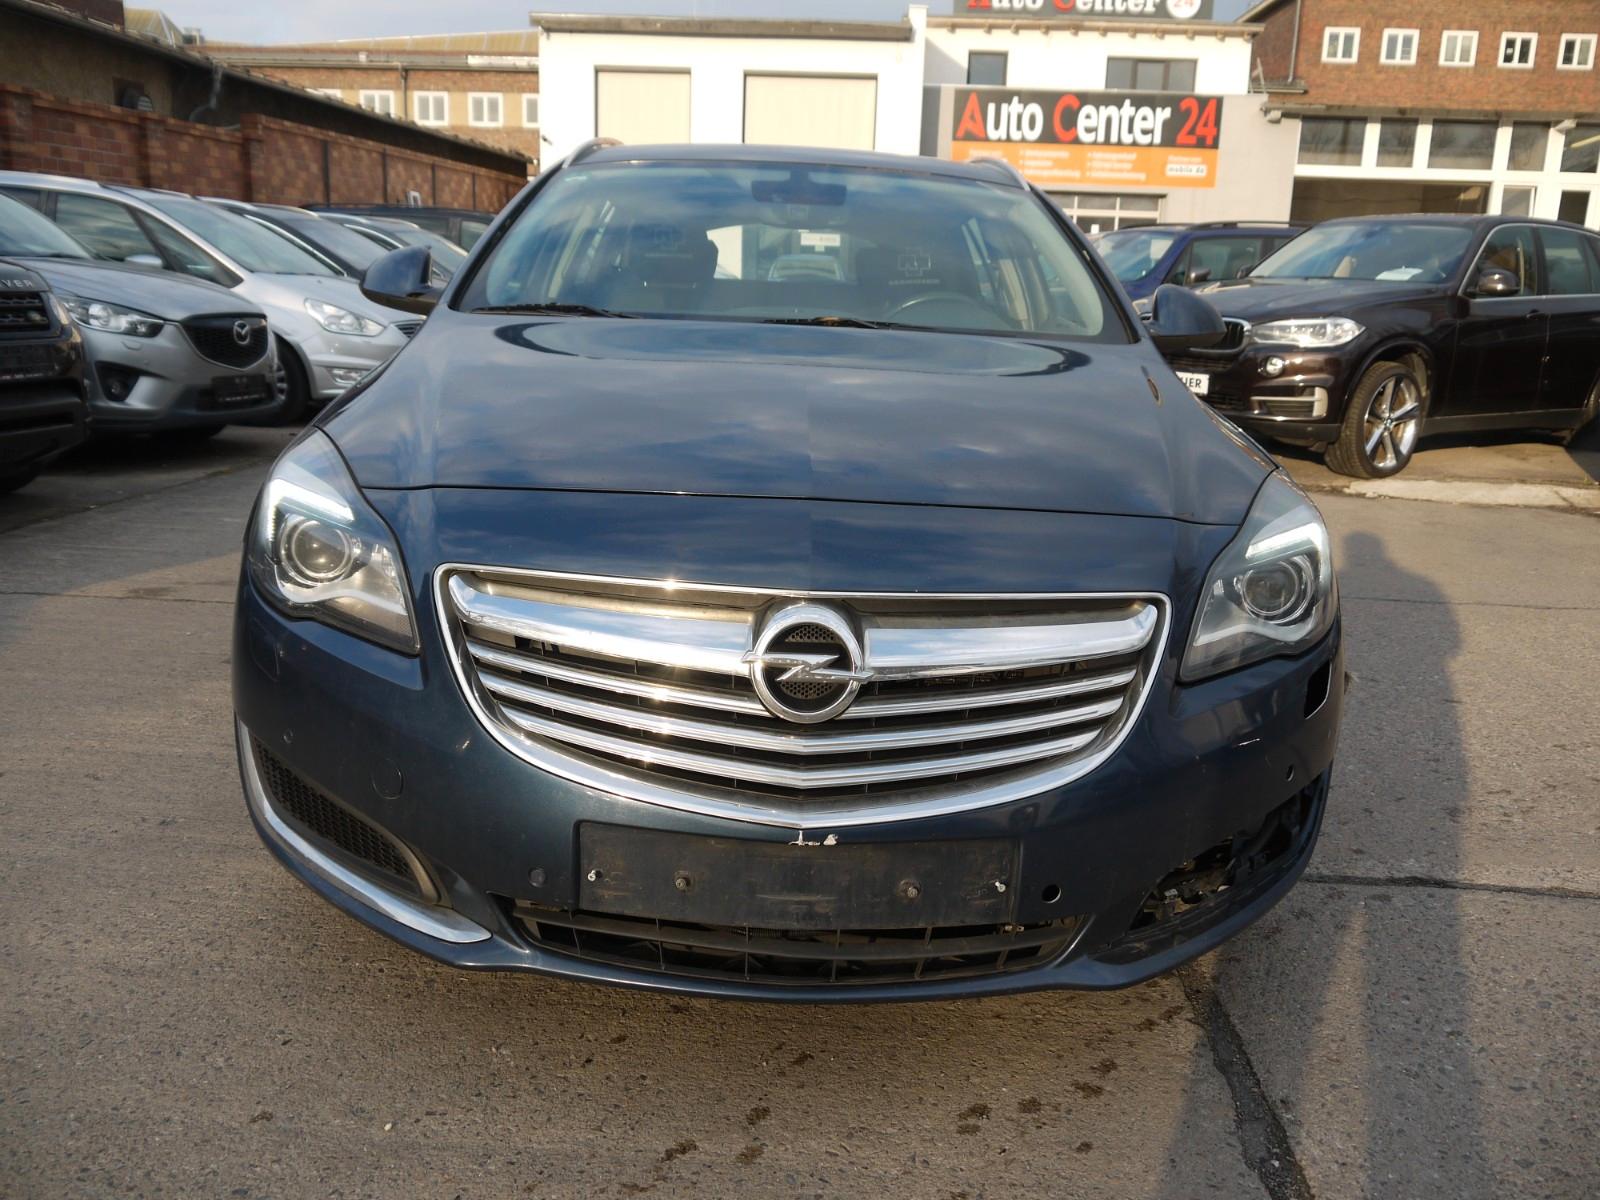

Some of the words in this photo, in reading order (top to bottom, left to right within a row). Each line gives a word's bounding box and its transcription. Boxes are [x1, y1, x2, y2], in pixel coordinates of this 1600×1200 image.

[956, 92, 1043, 141] Auto
[1053, 94, 1171, 145] Center
[1176, 97, 1218, 146] 24
